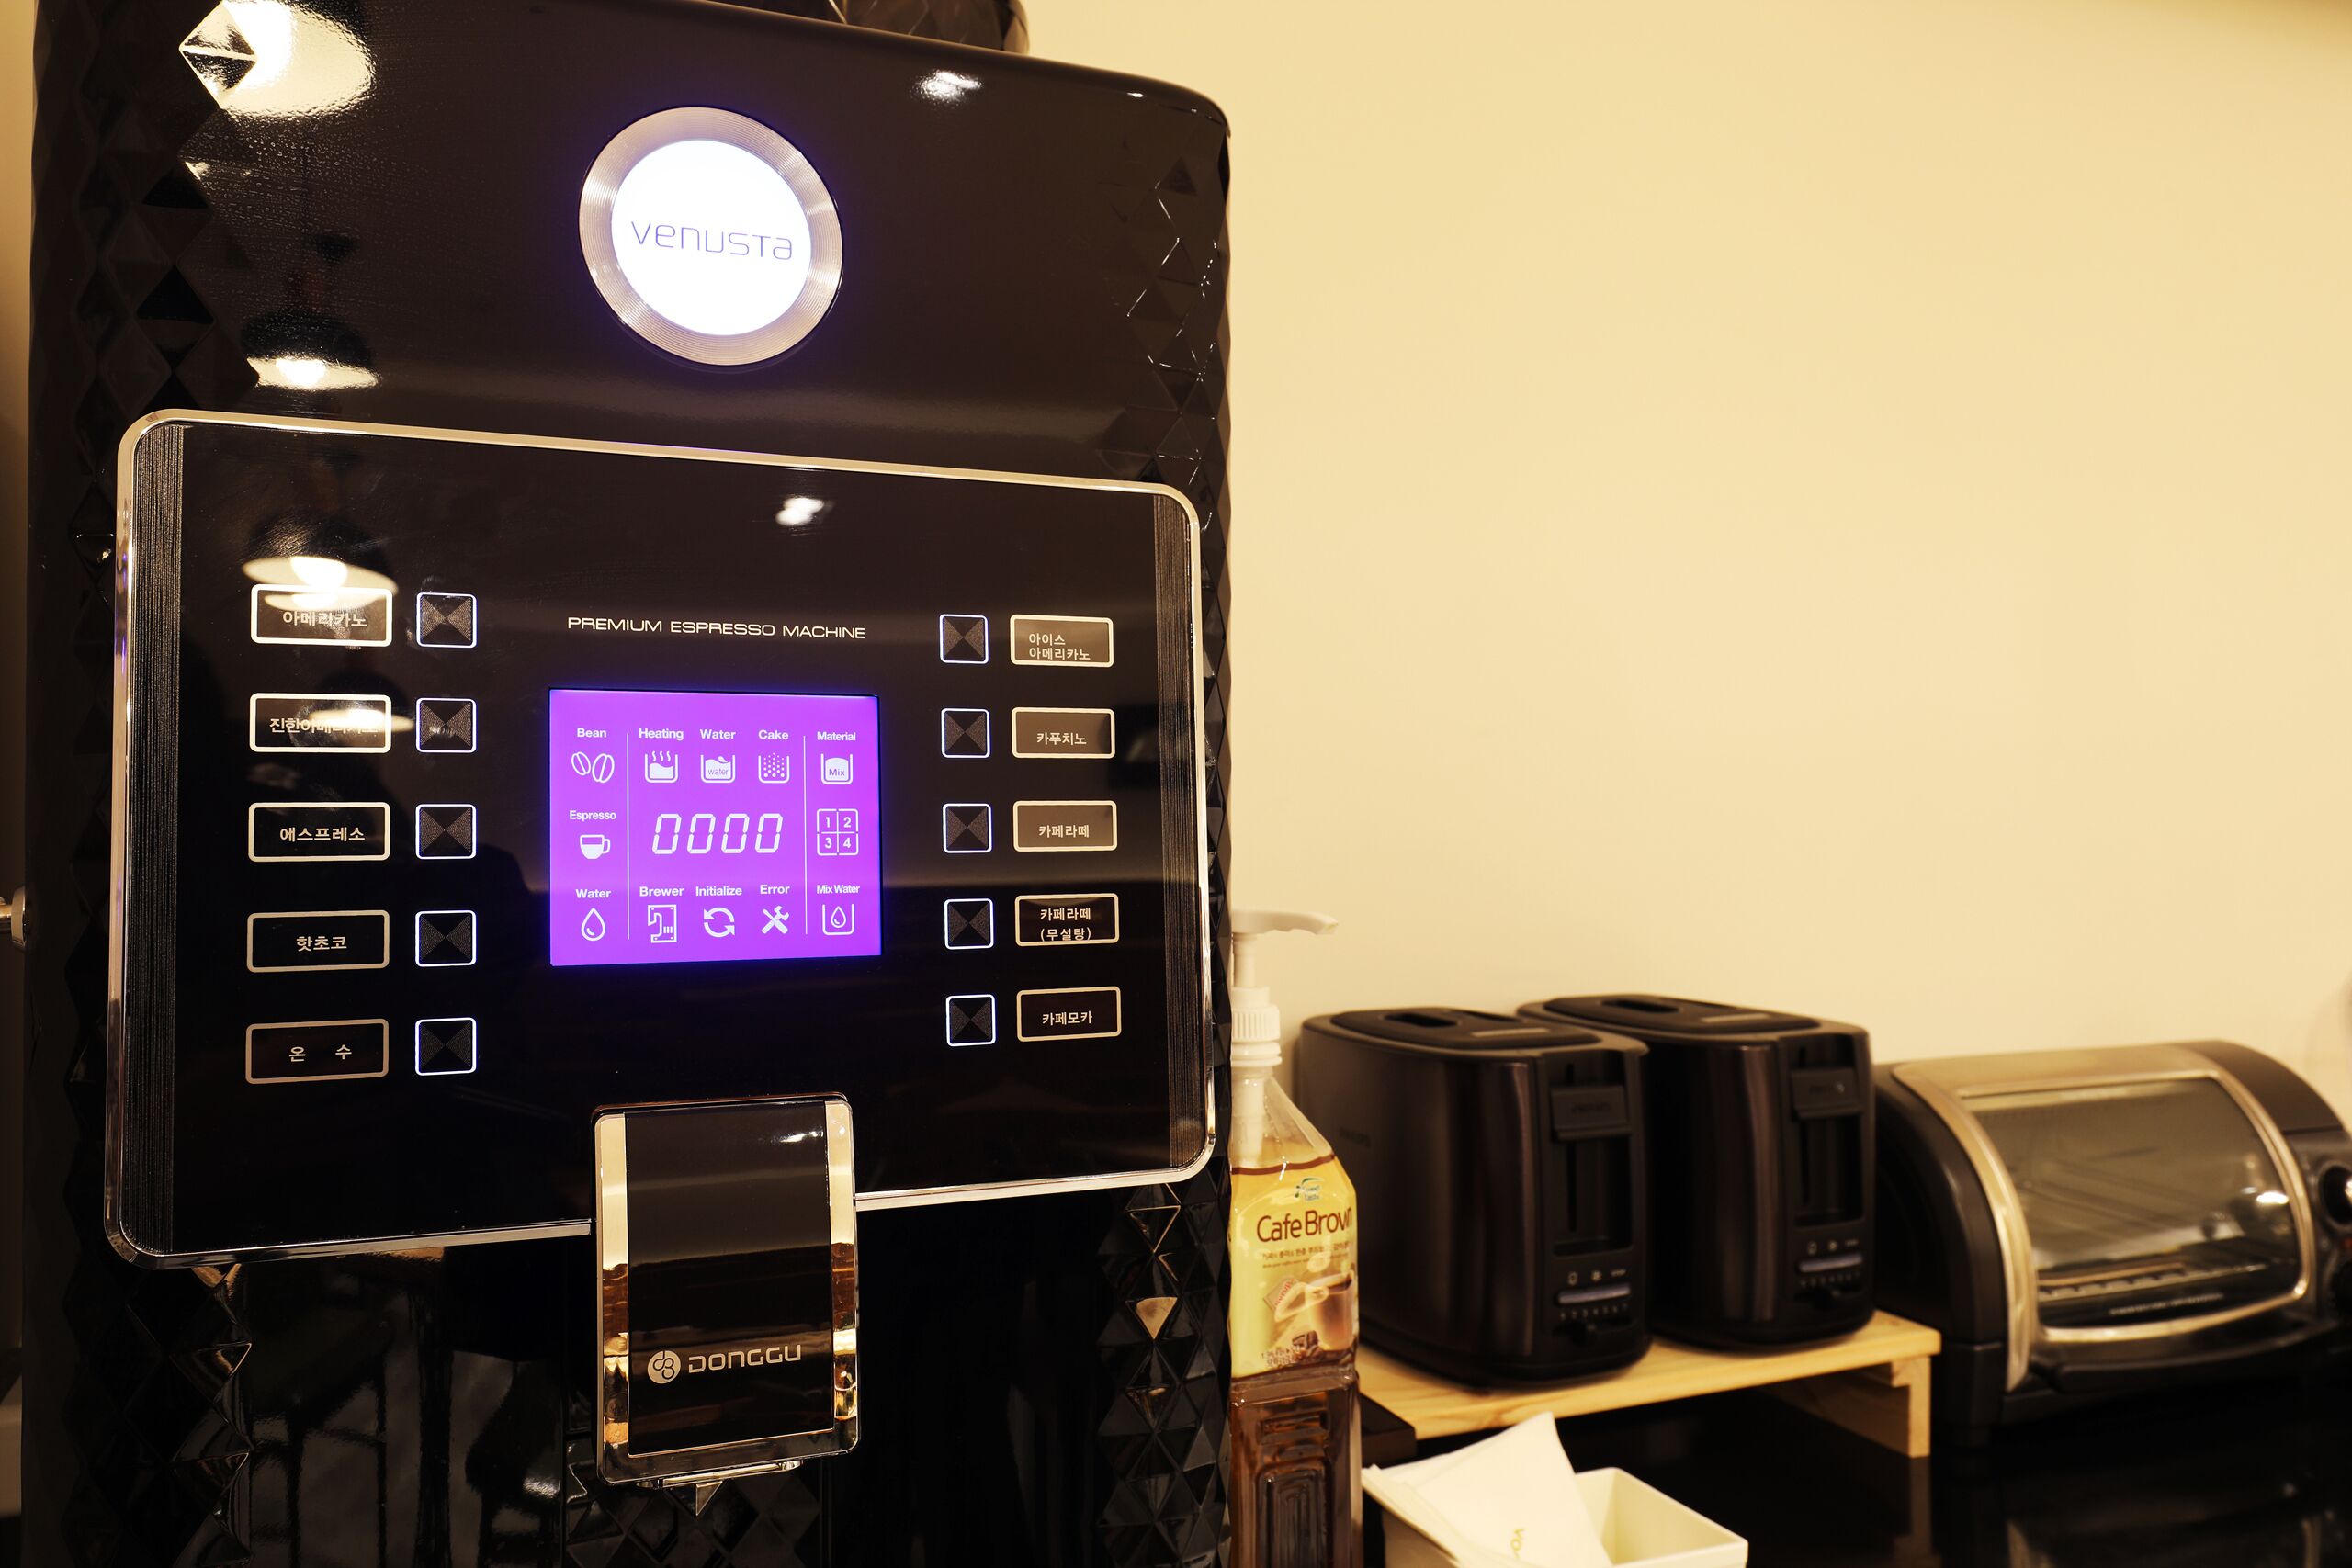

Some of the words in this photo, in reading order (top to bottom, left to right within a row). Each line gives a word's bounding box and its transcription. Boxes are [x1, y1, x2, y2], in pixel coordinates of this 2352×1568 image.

[282, 610, 368, 627] 아메리카노
[568, 616, 662, 633] PREMIUM
[670, 621, 775, 637] ESPRESSO
[782, 625, 865, 640] MACHINE
[1028, 633, 1066, 646] 아이스
[1028, 647, 1091, 660] 아메리카노
[576, 728, 607, 739] Bean
[639, 728, 684, 741] Heating
[699, 728, 736, 740] Water
[758, 729, 790, 740] Cake
[817, 731, 856, 742] Material
[1036, 732, 1087, 746] 카푸치노
[829, 768, 845, 777] Mix
[569, 810, 616, 822] Espresso
[825, 817, 831, 829] 1
[842, 817, 852, 829] 2
[279, 827, 366, 842] 에스프레소
[651, 813, 784, 854] 0000
[1038, 824, 1090, 839] 카페라떼
[824, 838, 832, 850] 3
[842, 838, 852, 850] 4
[575, 888, 612, 900] Water
[639, 886, 684, 897] Brewer
[695, 886, 743, 897] Initialize
[760, 884, 791, 896] Error
[816, 884, 835, 895] Mix
[835, 883, 861, 895] Water
[1040, 907, 1091, 921] 카페라떼
[1040, 927, 1091, 942] (무설탕)
[296, 935, 347, 952] 핫초코
[1042, 1011, 1092, 1026] 카페모카
[1256, 1213, 1302, 1242] Cafe
[688, 1344, 802, 1374] DONGGU
